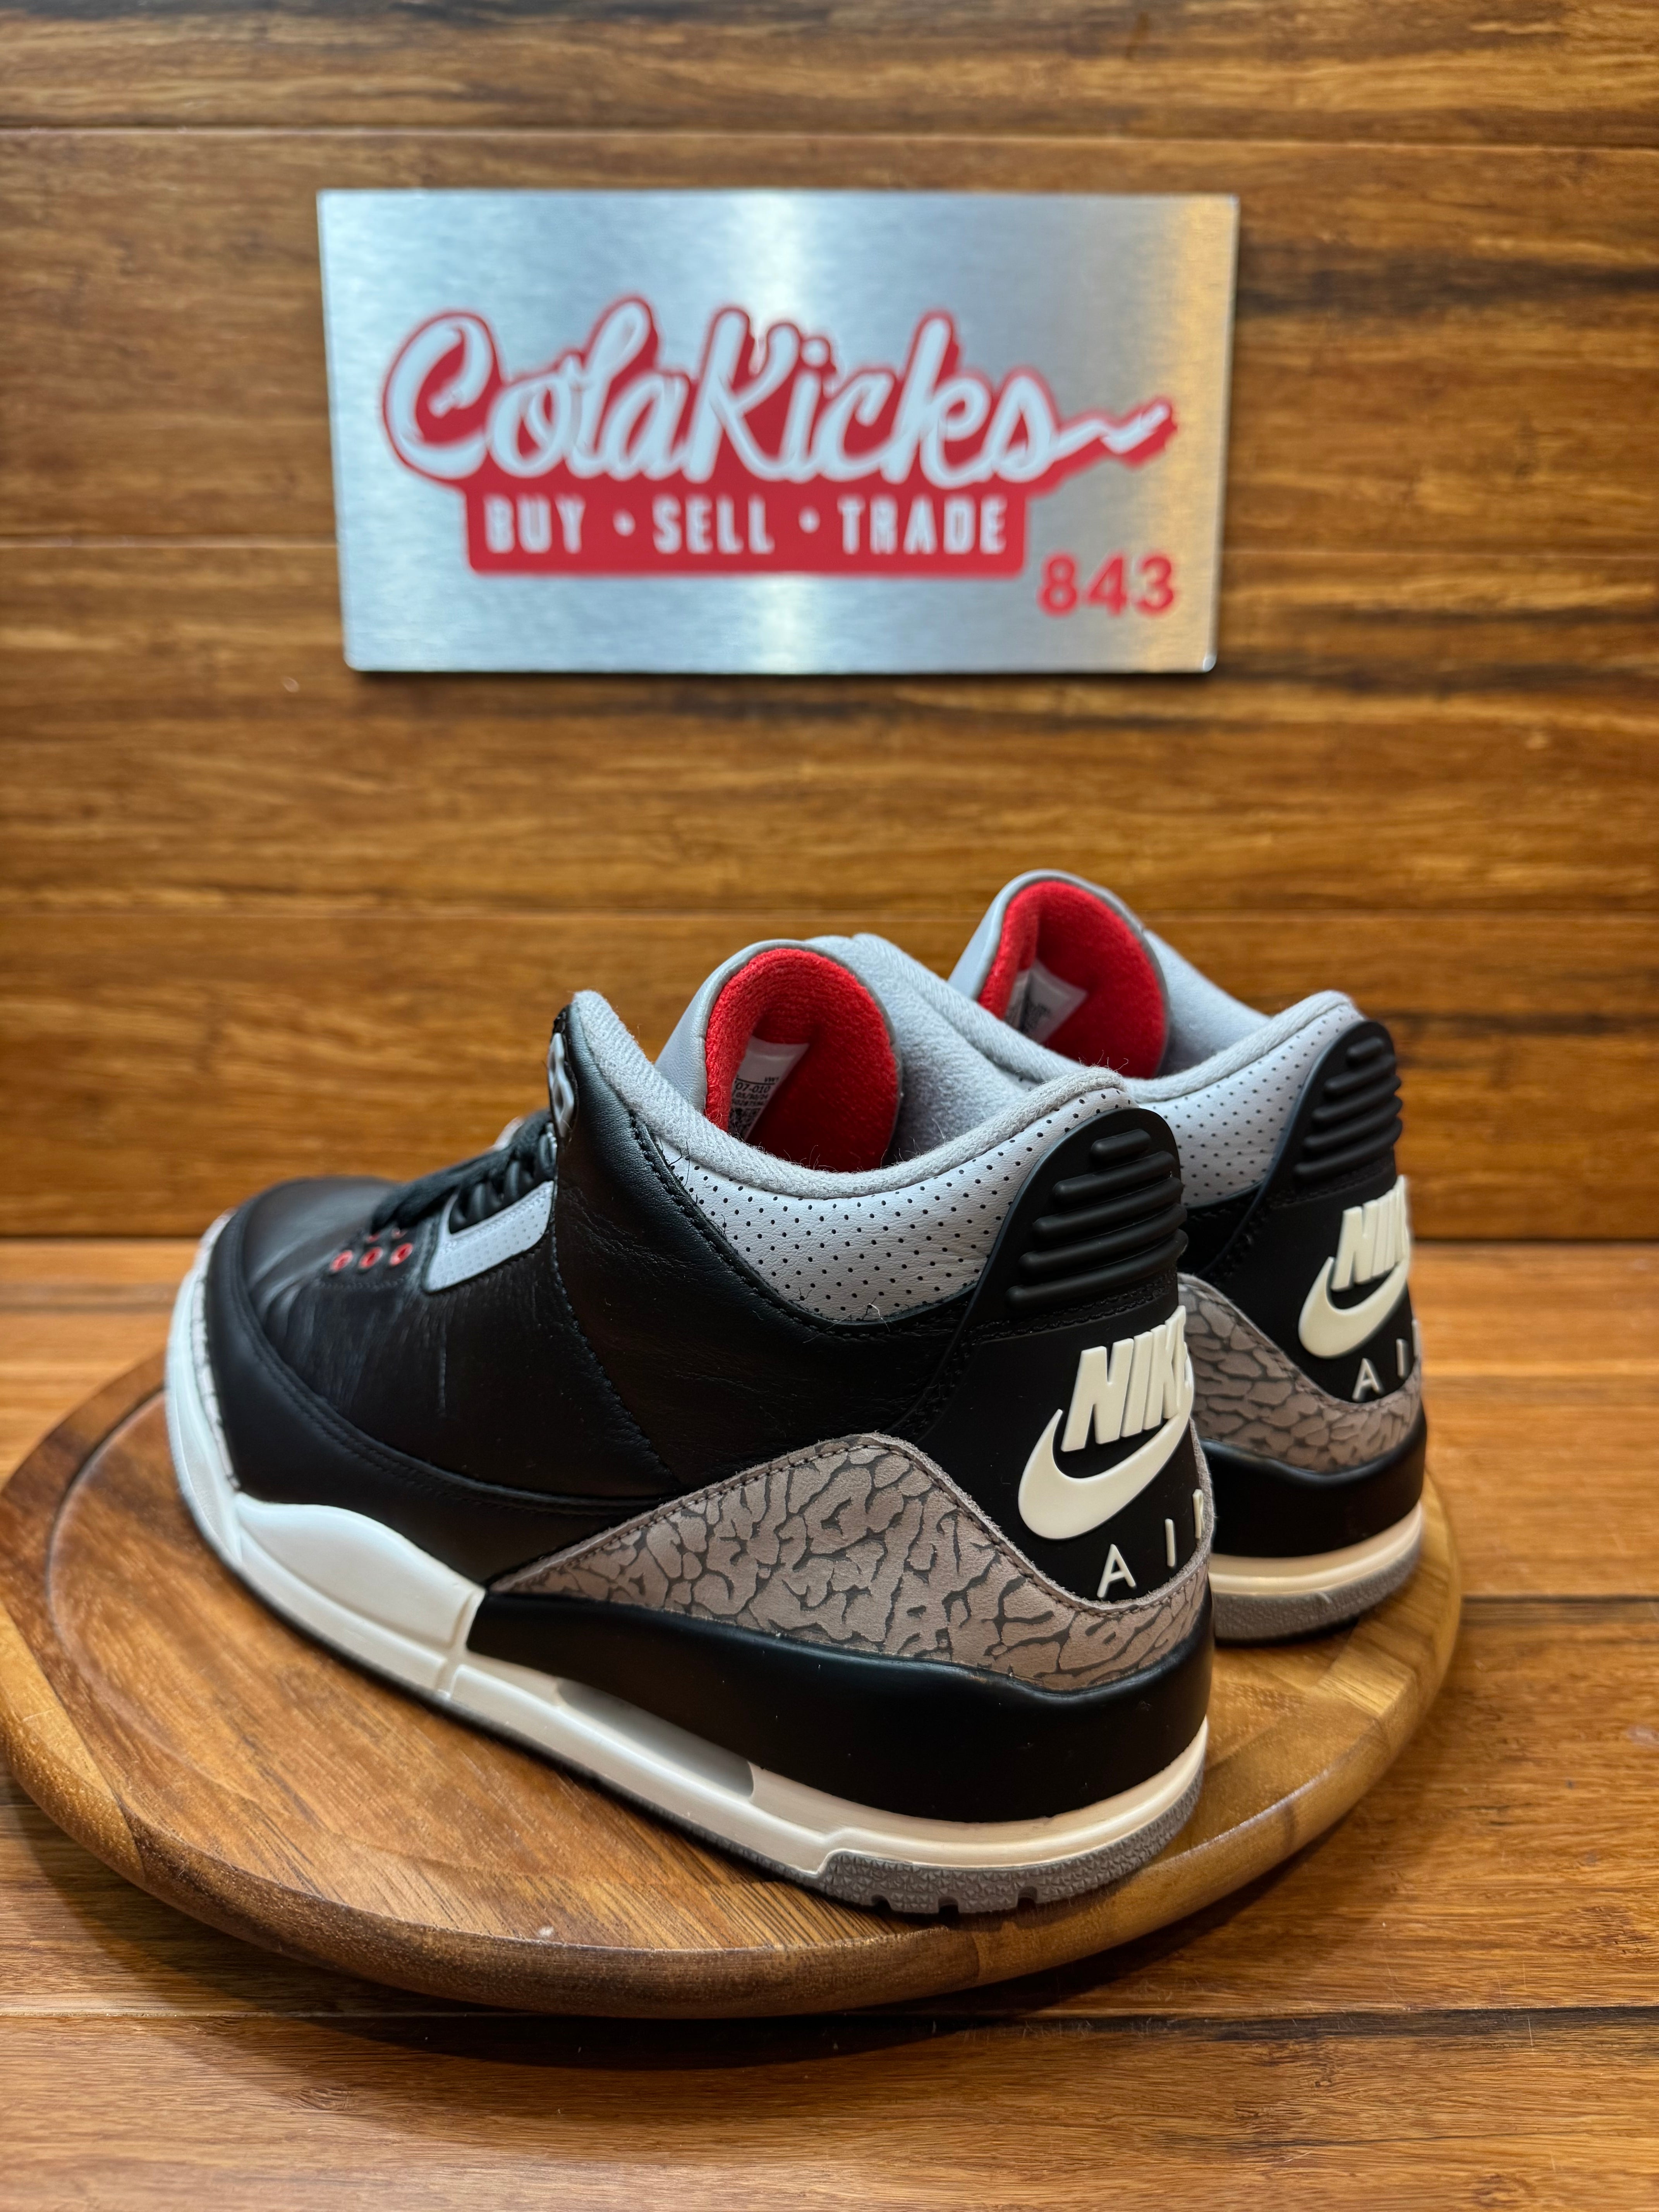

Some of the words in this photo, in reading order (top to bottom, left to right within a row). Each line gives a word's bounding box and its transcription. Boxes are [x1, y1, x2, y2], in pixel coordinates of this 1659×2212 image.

[386, 297, 1175, 489] ColaKicks
[483, 493, 586, 554] BUY
[652, 493, 775, 555] SELL
[837, 494, 1006, 554] TRADE
[1037, 551, 1174, 617] 843
[734, 1080, 771, 1093] 07-010
[1331, 1175, 1410, 1292] NIK
[1352, 1319, 1420, 1401] AI
